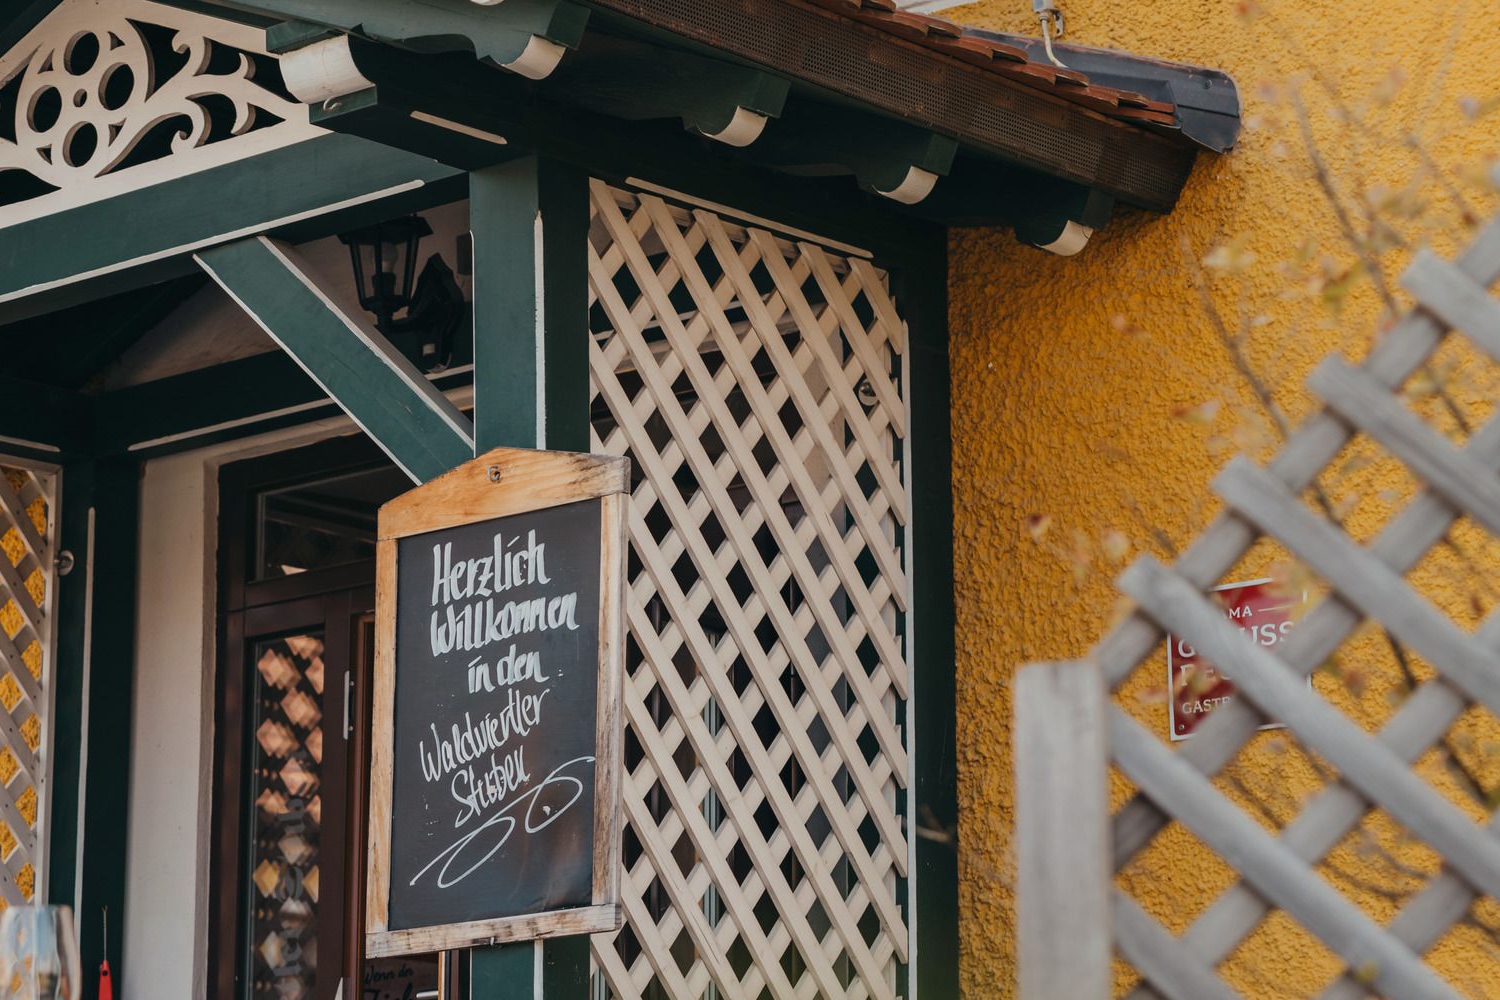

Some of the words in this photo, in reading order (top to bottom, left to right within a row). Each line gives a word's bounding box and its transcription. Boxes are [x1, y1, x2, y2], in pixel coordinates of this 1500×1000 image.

[431, 529, 551, 606] Herzlich
[468, 656, 496, 694] in
[497, 643, 550, 686] den
